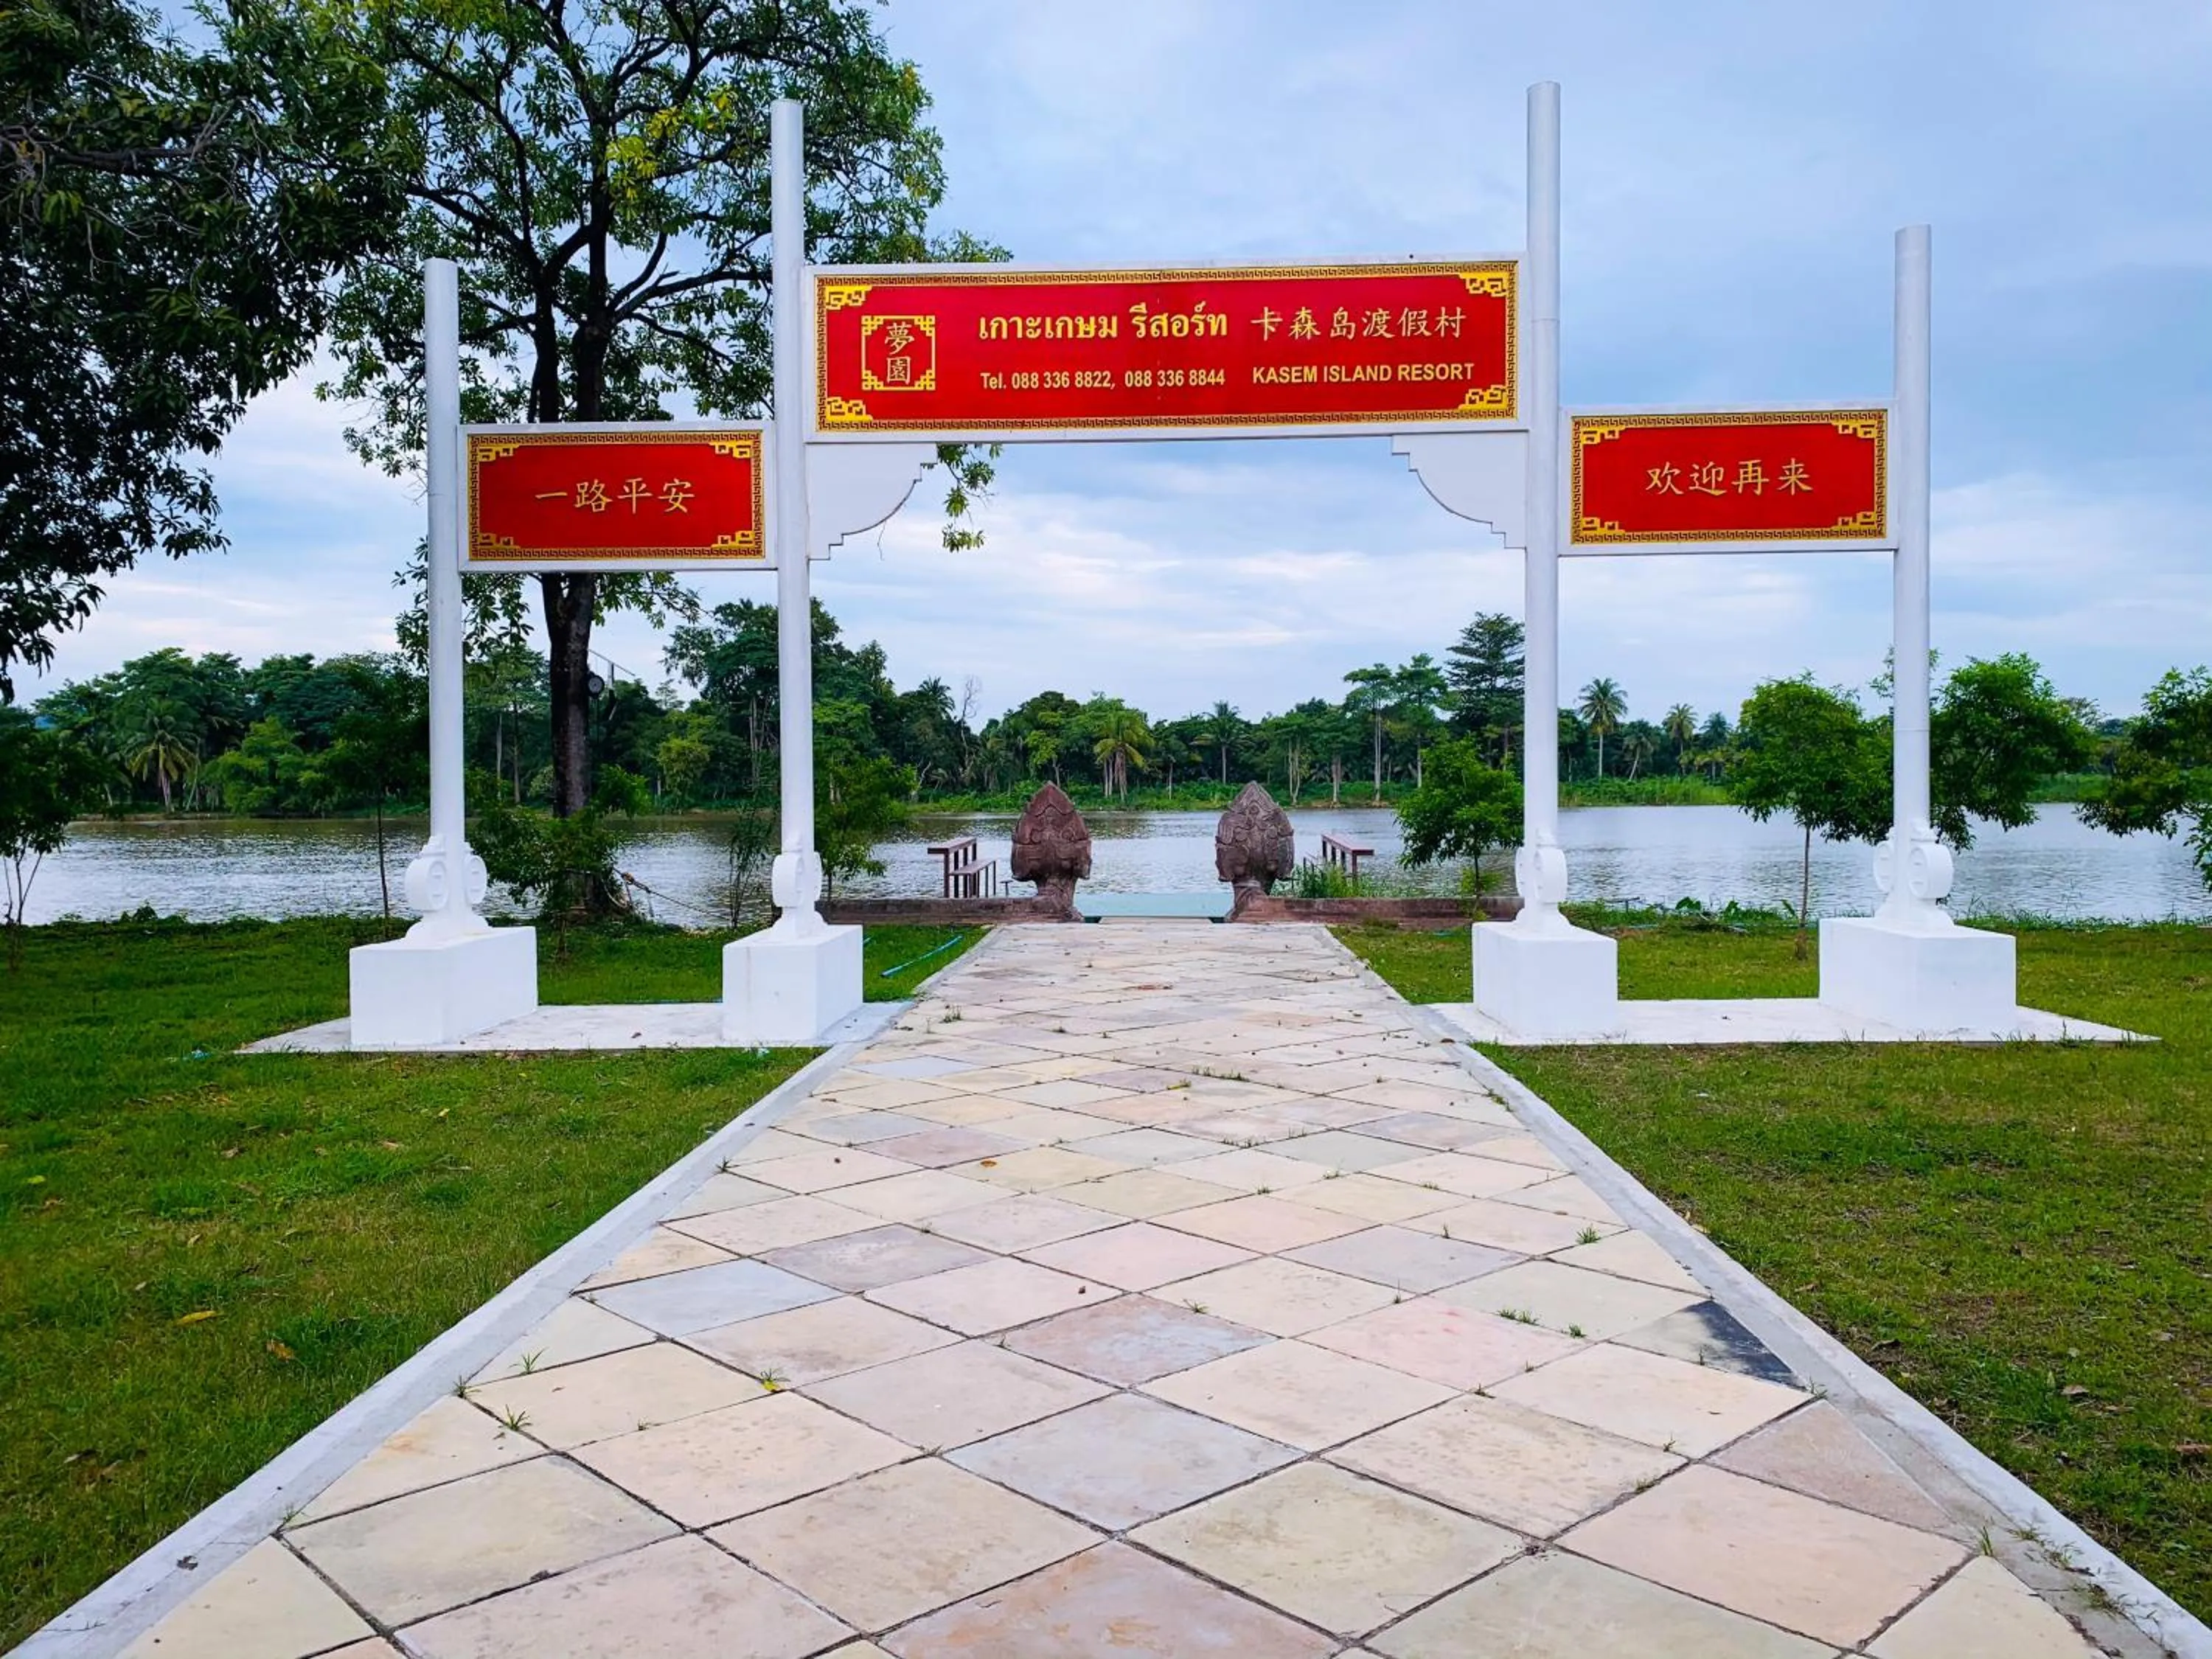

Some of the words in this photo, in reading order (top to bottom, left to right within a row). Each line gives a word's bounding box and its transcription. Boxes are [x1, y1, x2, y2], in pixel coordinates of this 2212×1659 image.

[978, 316, 1118, 340] เกาะเกษม
[1129, 301, 1227, 338] รีสอร์ท
[1251, 306, 1467, 341] 卡森岛渡假村
[980, 372, 1006, 389] Tel.
[1011, 372, 1039, 389] 088
[1043, 371, 1070, 389] 336
[1074, 371, 1116, 390] 8822,
[1124, 370, 1152, 387] 088
[1157, 369, 1184, 387] 336
[1189, 369, 1225, 386] 8844
[1253, 366, 1318, 384] KASEM
[1324, 364, 1392, 383] ISLAND
[1398, 362, 1475, 381] RESORT
[1646, 457, 1813, 496] 欢迎再来
[535, 477, 695, 515] 一路平安
